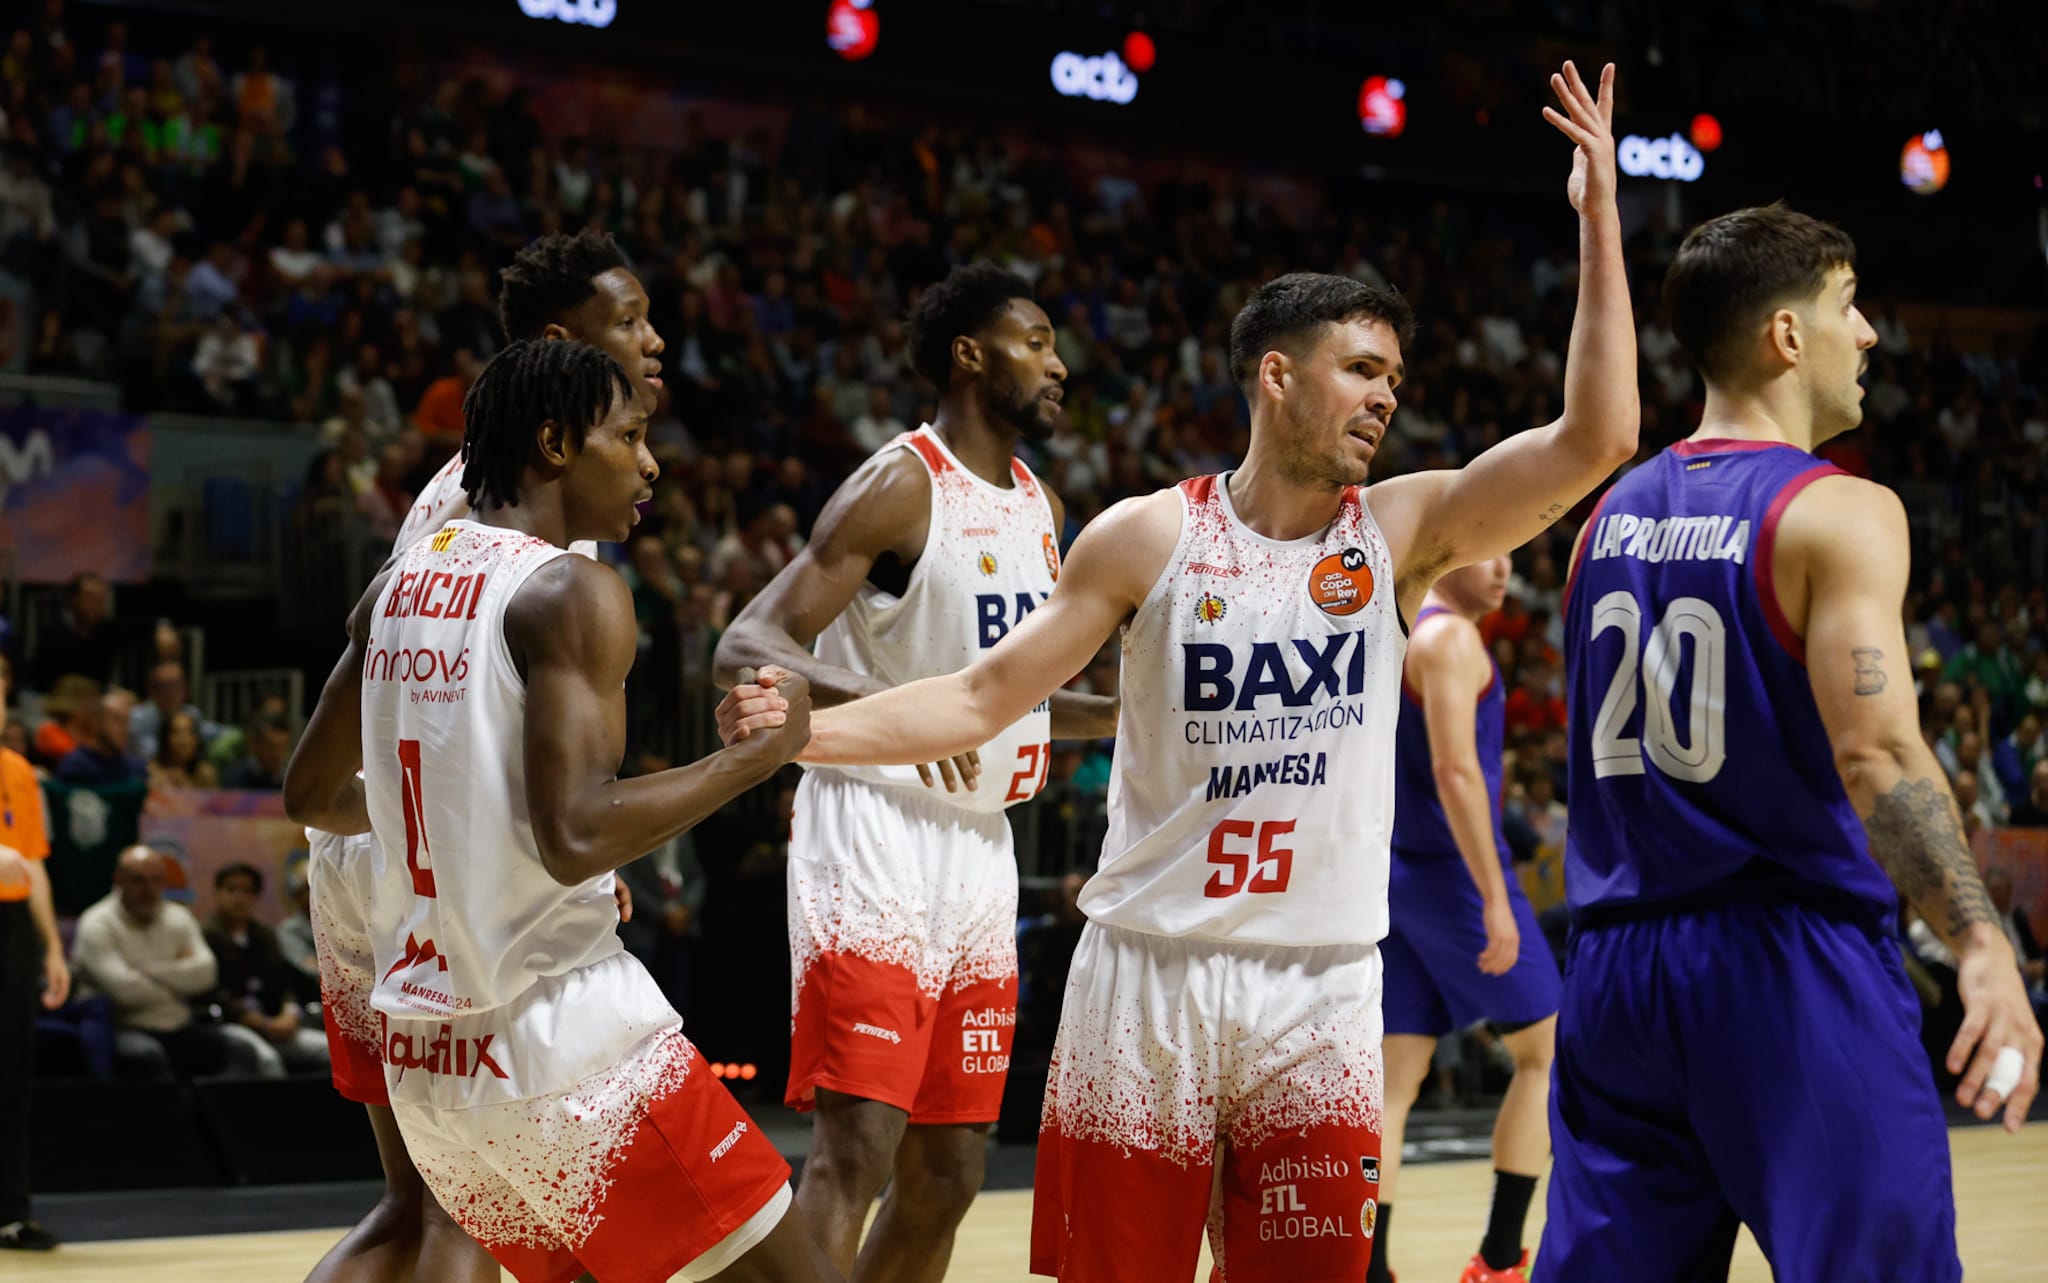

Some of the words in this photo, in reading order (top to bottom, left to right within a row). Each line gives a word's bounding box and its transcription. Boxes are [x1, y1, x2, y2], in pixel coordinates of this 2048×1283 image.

[1050, 50, 1138, 105] acb
[1618, 132, 1704, 182] acb
[1320, 578, 1353, 591] Copa
[1336, 587, 1358, 599] Rey
[1181, 628, 1366, 712] BAXI
[411, 689, 421, 704] by
[422, 687, 467, 704] AVINENT
[1591, 590, 1727, 784] 20
[1184, 699, 1364, 745] CLIMATIZACIÓN
[1205, 751, 1327, 803] MANRESA
[1204, 817, 1298, 898] 55
[961, 1007, 1017, 1028] Adbisi
[961, 1029, 1002, 1053] ETL
[961, 1054, 1011, 1074] GLOBA
[1259, 1153, 1350, 1185] Adbisio
[1260, 1184, 1307, 1214] ETL
[1259, 1215, 1353, 1241] GLOBAL
